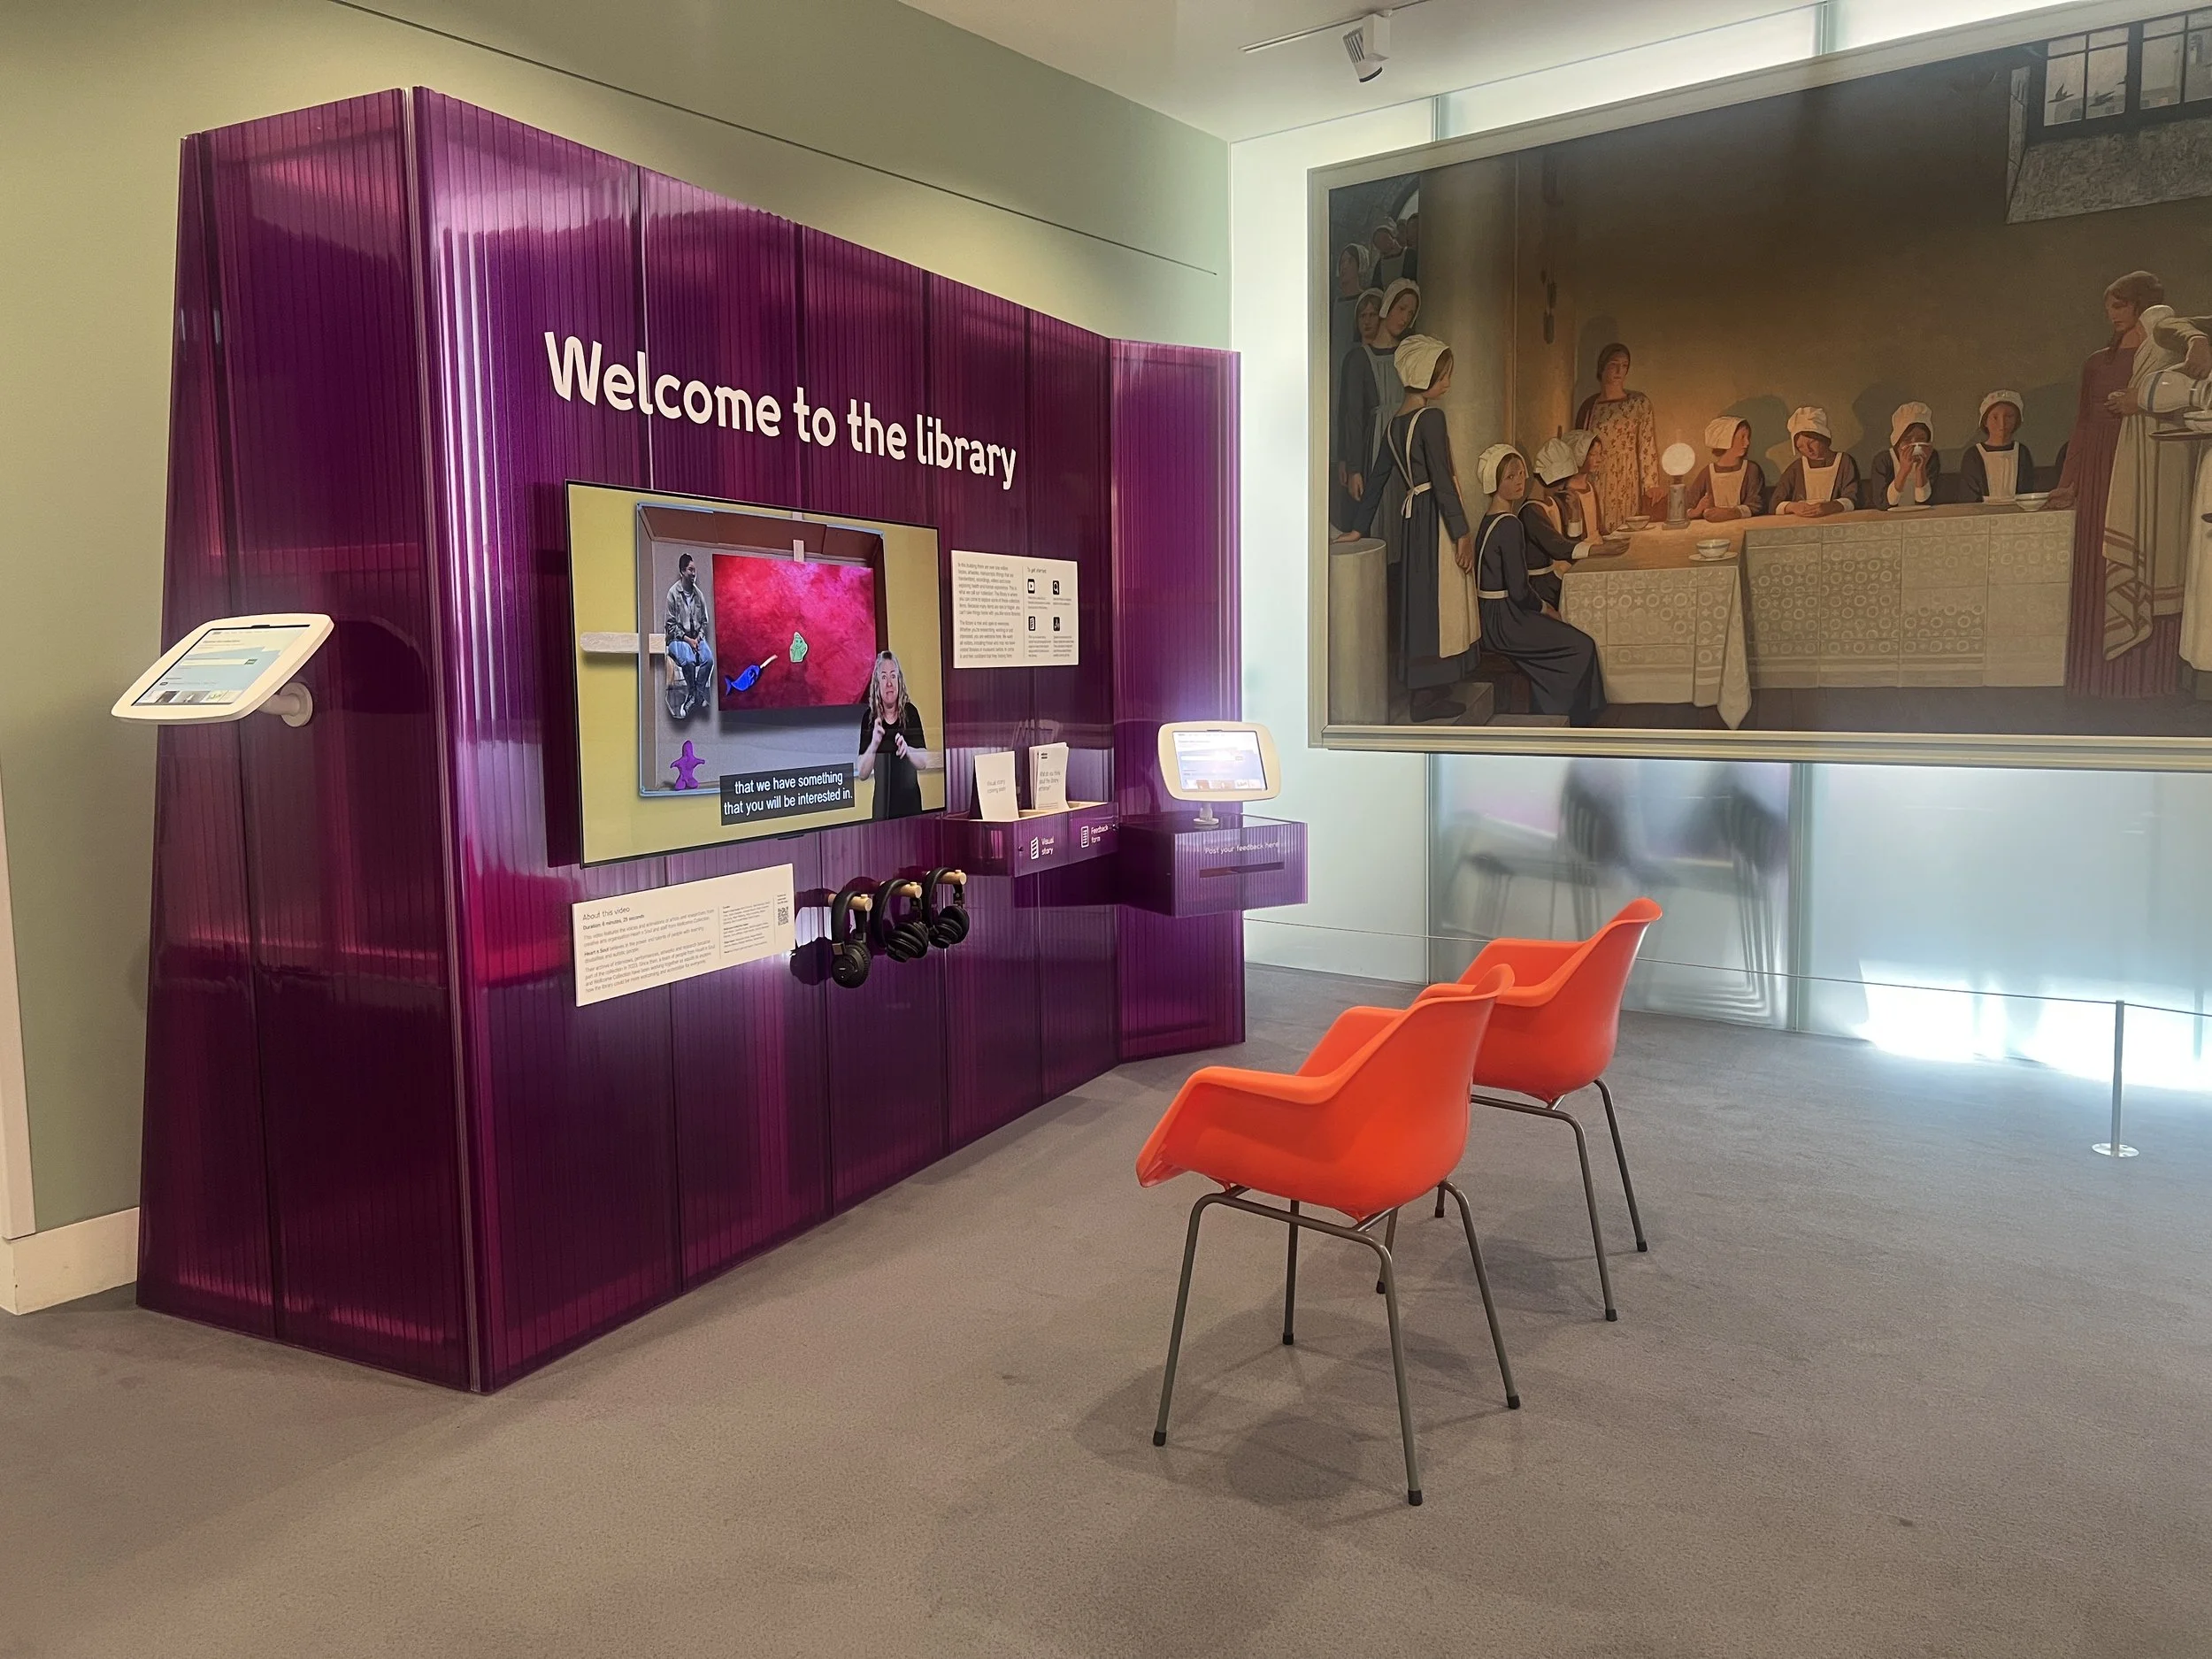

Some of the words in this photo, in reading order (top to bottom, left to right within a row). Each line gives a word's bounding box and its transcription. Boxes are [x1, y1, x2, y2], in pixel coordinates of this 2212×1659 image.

[544, 332, 781, 437] Welcome
[794, 387, 836, 447] to
[848, 399, 906, 461] the
[917, 414, 1017, 490] library
[735, 780, 754, 794] that
[757, 781, 770, 792] we
[773, 778, 796, 790] have
[798, 772, 843, 787] something
[724, 801, 743, 815] that
[746, 801, 764, 816] you
[766, 795, 781, 809] will
[784, 795, 796, 807] be
[798, 788, 840, 805] interested
[843, 787, 853, 799] in.
[1091, 825, 1108, 834] Feedback
[1041, 836, 1054, 845] Visual
[583, 911, 600, 920] About
